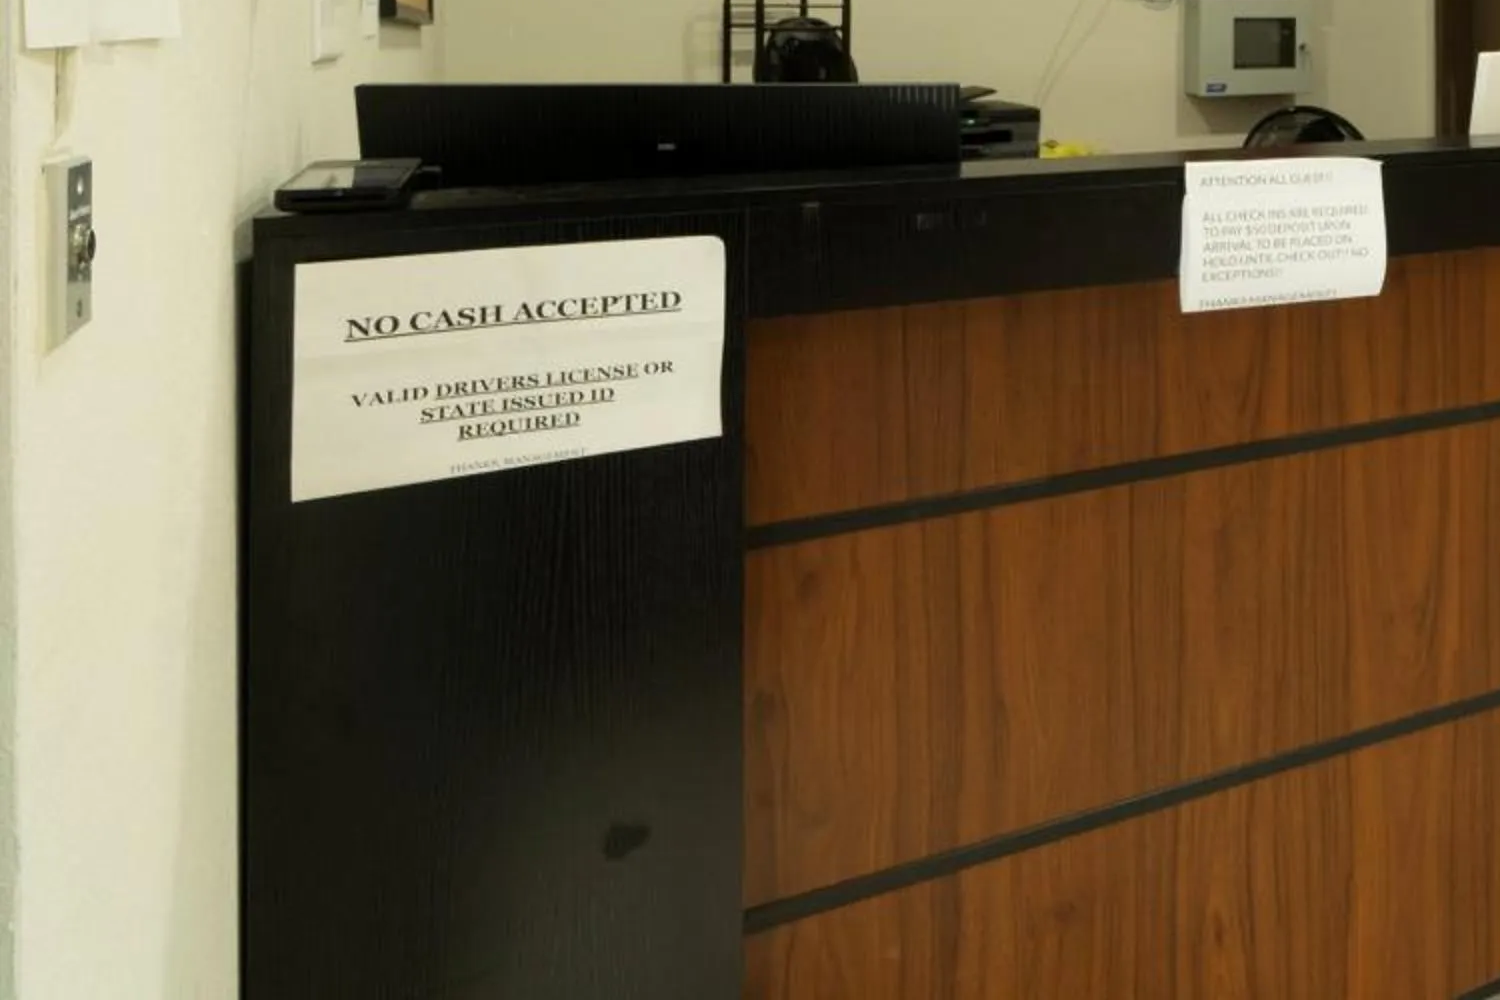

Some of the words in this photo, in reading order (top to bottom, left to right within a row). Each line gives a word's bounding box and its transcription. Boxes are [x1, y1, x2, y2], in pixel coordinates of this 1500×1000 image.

[1202, 238, 1253, 253] ARRIVAL
[1256, 237, 1271, 250] TO
[1273, 236, 1288, 249] BE
[1290, 234, 1333, 248] PLACED
[1203, 225, 1220, 237] TO
[344, 315, 401, 342] NO
[409, 303, 503, 332] CASH
[512, 290, 683, 323] ACCEPTED
[351, 385, 430, 408] VALID
[435, 373, 540, 401] DRIVERS
[545, 362, 640, 386] LICENSE
[643, 359, 675, 376] OR
[419, 399, 500, 425] STATE
[501, 389, 586, 414] ISSUED
[590, 387, 616, 403] ID
[457, 411, 581, 442] REQUIRED
